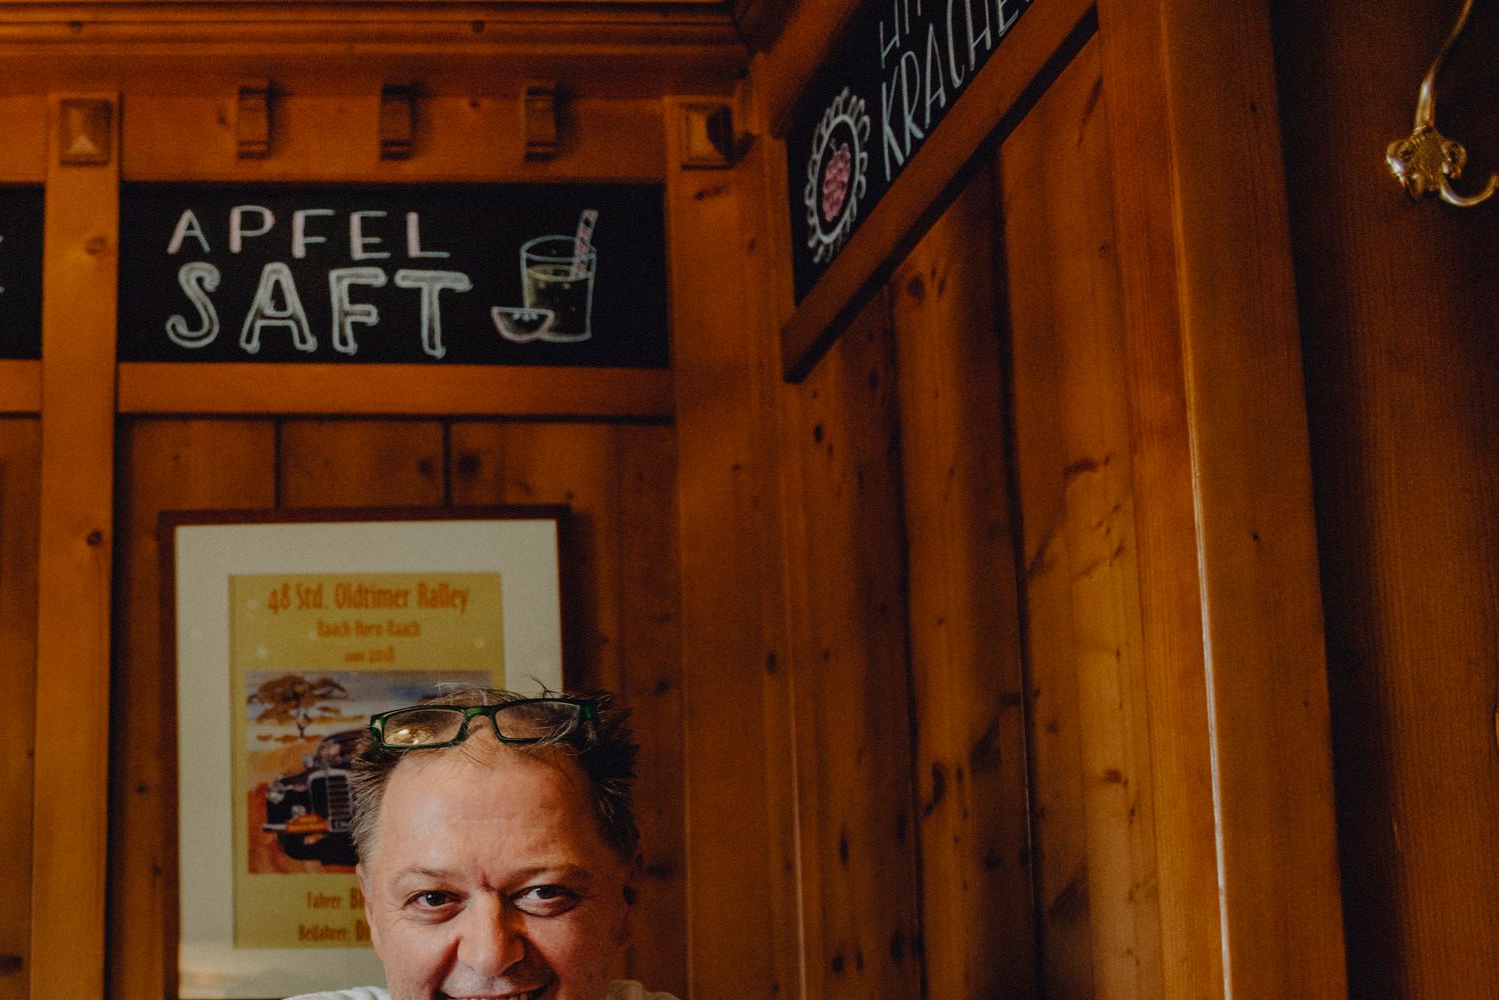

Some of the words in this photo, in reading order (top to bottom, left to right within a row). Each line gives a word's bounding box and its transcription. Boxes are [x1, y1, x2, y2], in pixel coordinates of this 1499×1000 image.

[167, 205, 451, 260] APFEL
[166, 262, 474, 359] SAFT
[268, 582, 291, 614] 48
[334, 582, 411, 611] Oldtimer
